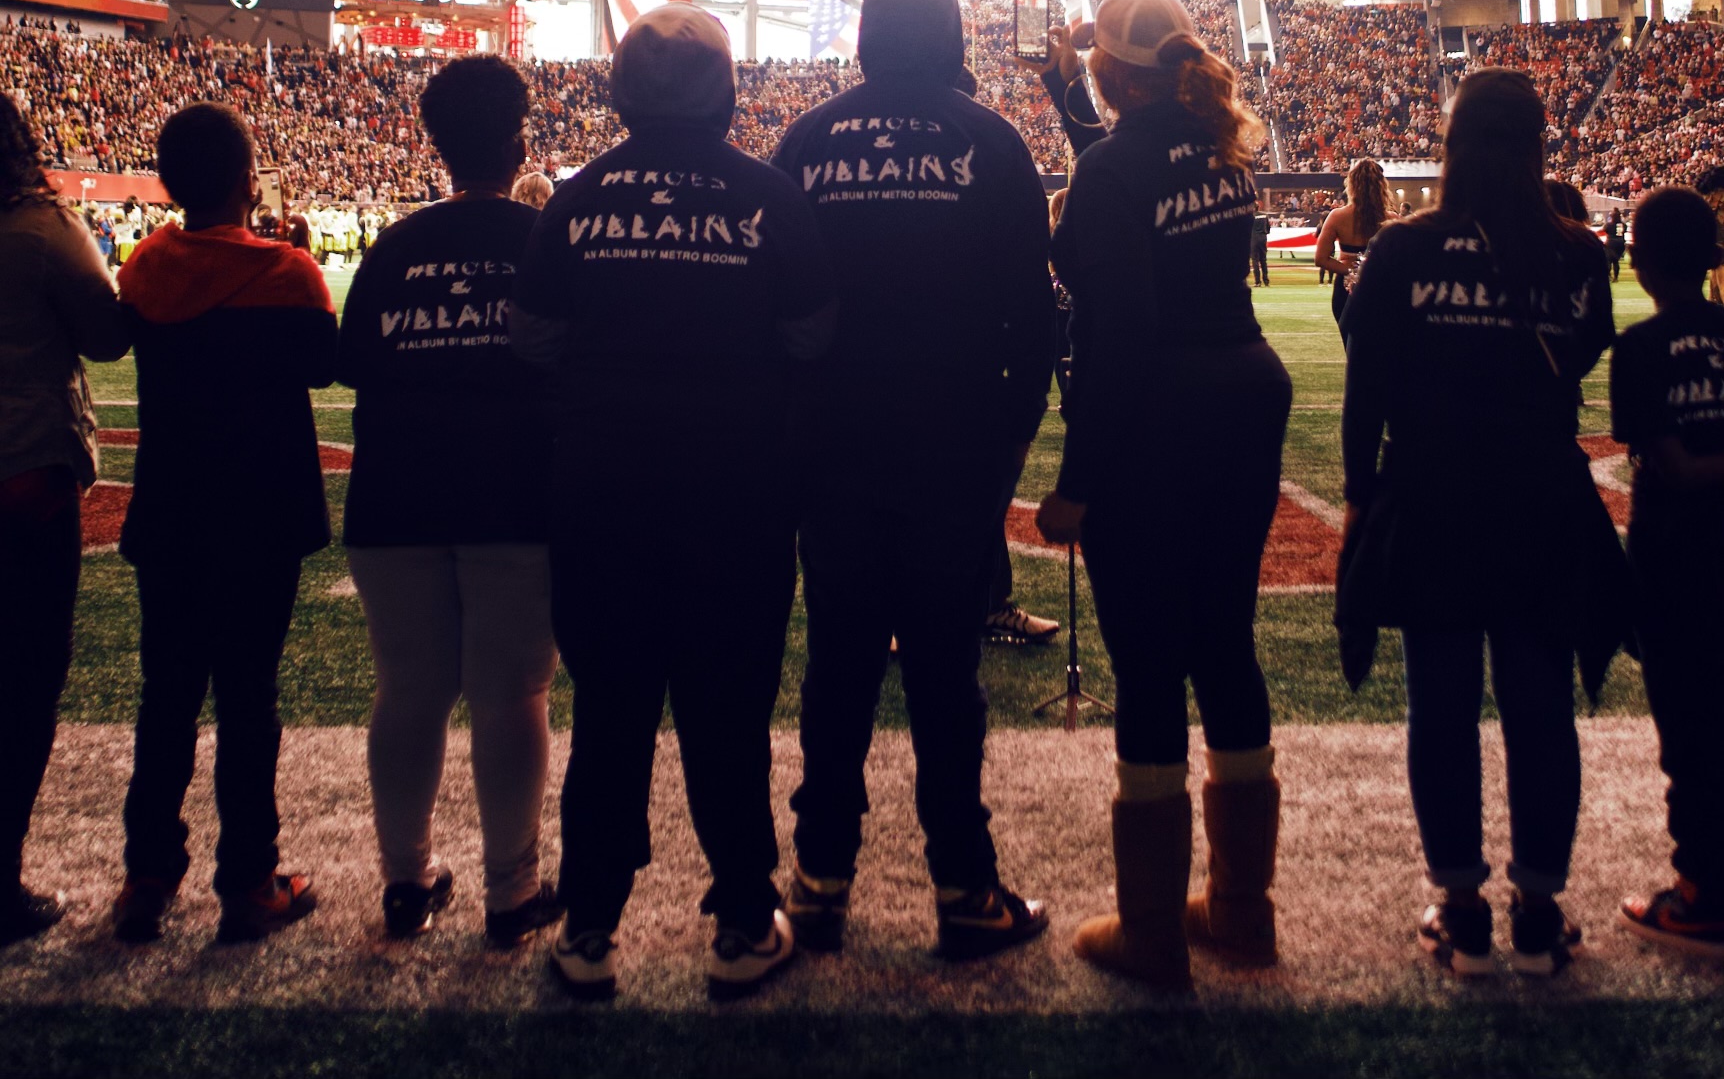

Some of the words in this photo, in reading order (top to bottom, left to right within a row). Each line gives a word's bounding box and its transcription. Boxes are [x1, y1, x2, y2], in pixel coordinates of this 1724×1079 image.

[873, 133, 896, 148] &
[802, 144, 976, 192] VILLAINS
[649, 189, 675, 205] &
[829, 190, 864, 201] ALBUM
[867, 190, 880, 200] BY
[881, 189, 916, 200] METRO
[917, 189, 960, 202] BOOMIN
[568, 207, 765, 248] VILLAINS
[1181, 215, 1210, 233] ALBUM
[1210, 211, 1222, 224] BY
[583, 250, 597, 261] AN
[598, 248, 638, 259] ALBUM
[640, 249, 656, 260] BY
[659, 249, 700, 262] METRO
[702, 252, 748, 266] BOOMIN
[449, 279, 472, 295] &
[1441, 314, 1478, 325] ALBUM
[1480, 315, 1496, 326] BY
[407, 337, 446, 350] ALBUM
